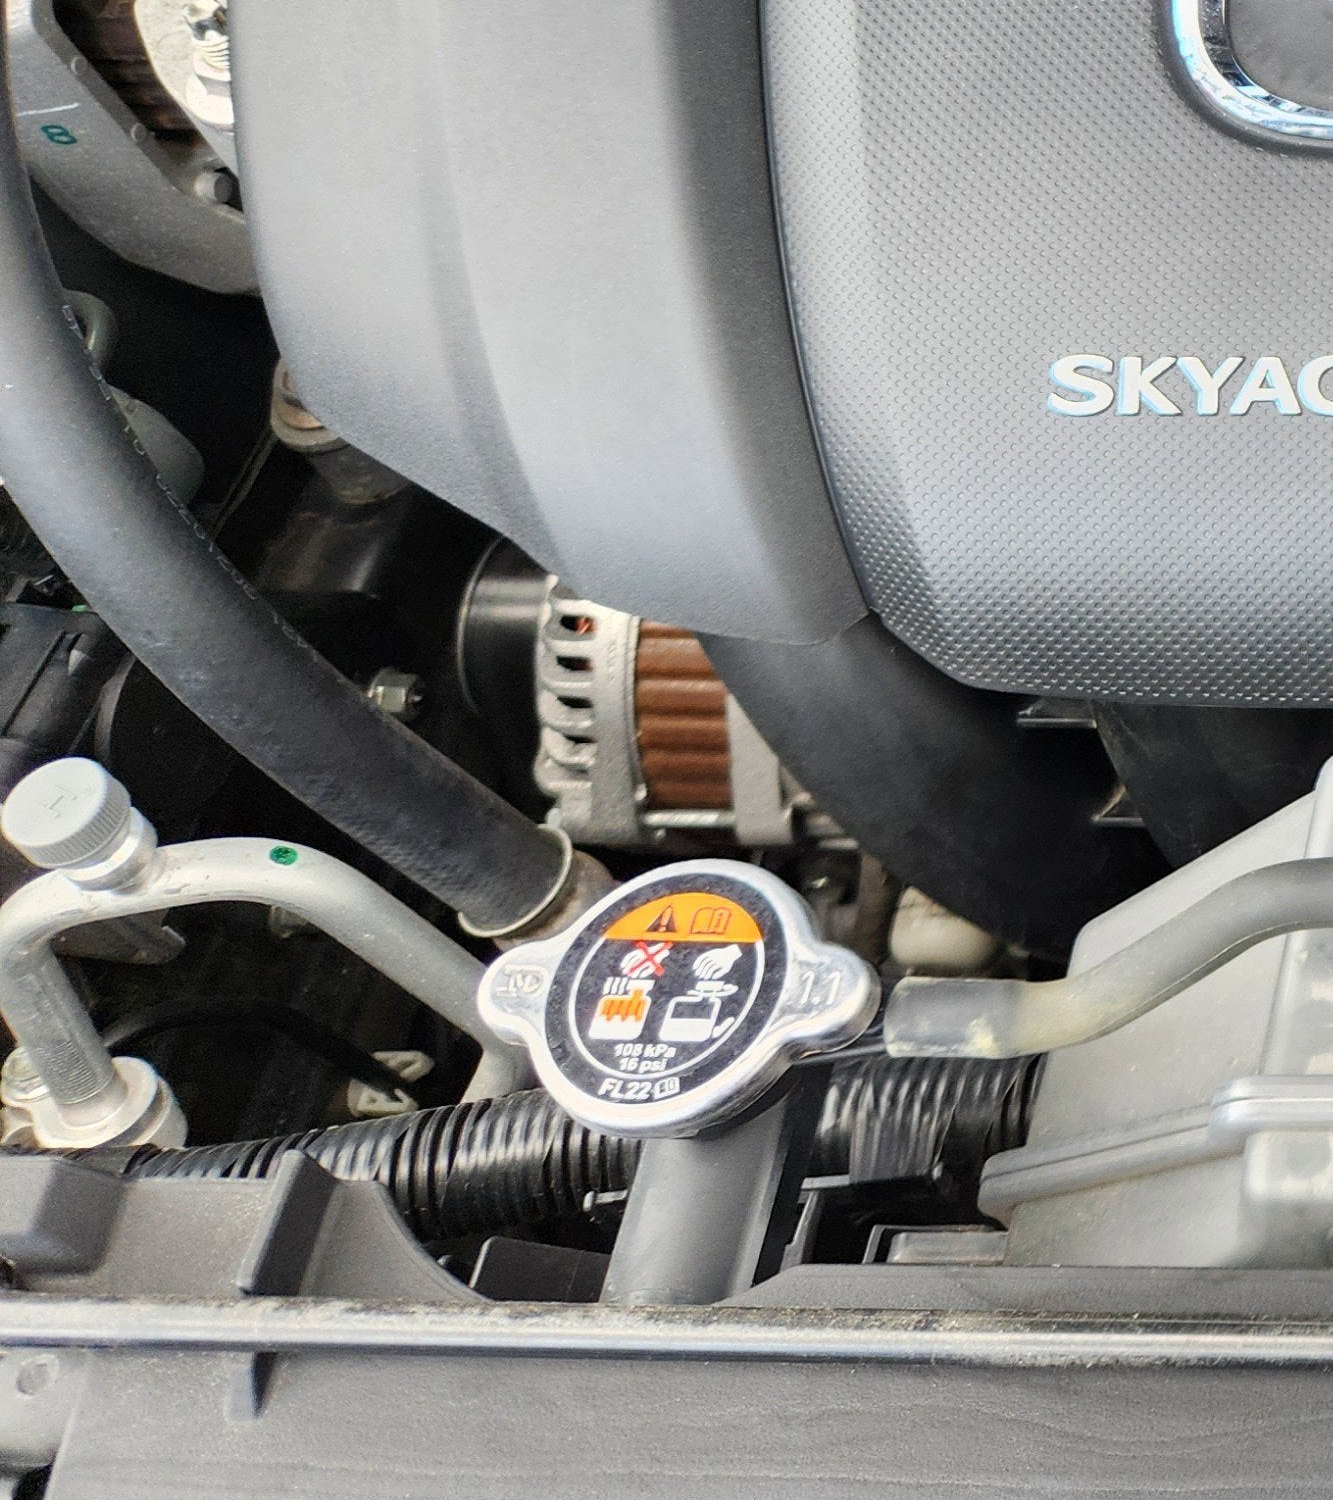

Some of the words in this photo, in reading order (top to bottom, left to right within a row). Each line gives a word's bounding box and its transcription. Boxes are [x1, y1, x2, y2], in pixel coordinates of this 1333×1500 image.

[613, 1043, 644, 1057] 108
[644, 1043, 678, 1058] kPa
[619, 1057, 640, 1071] 16
[639, 1058, 669, 1074] psi
[597, 1077, 653, 1100] FL22
